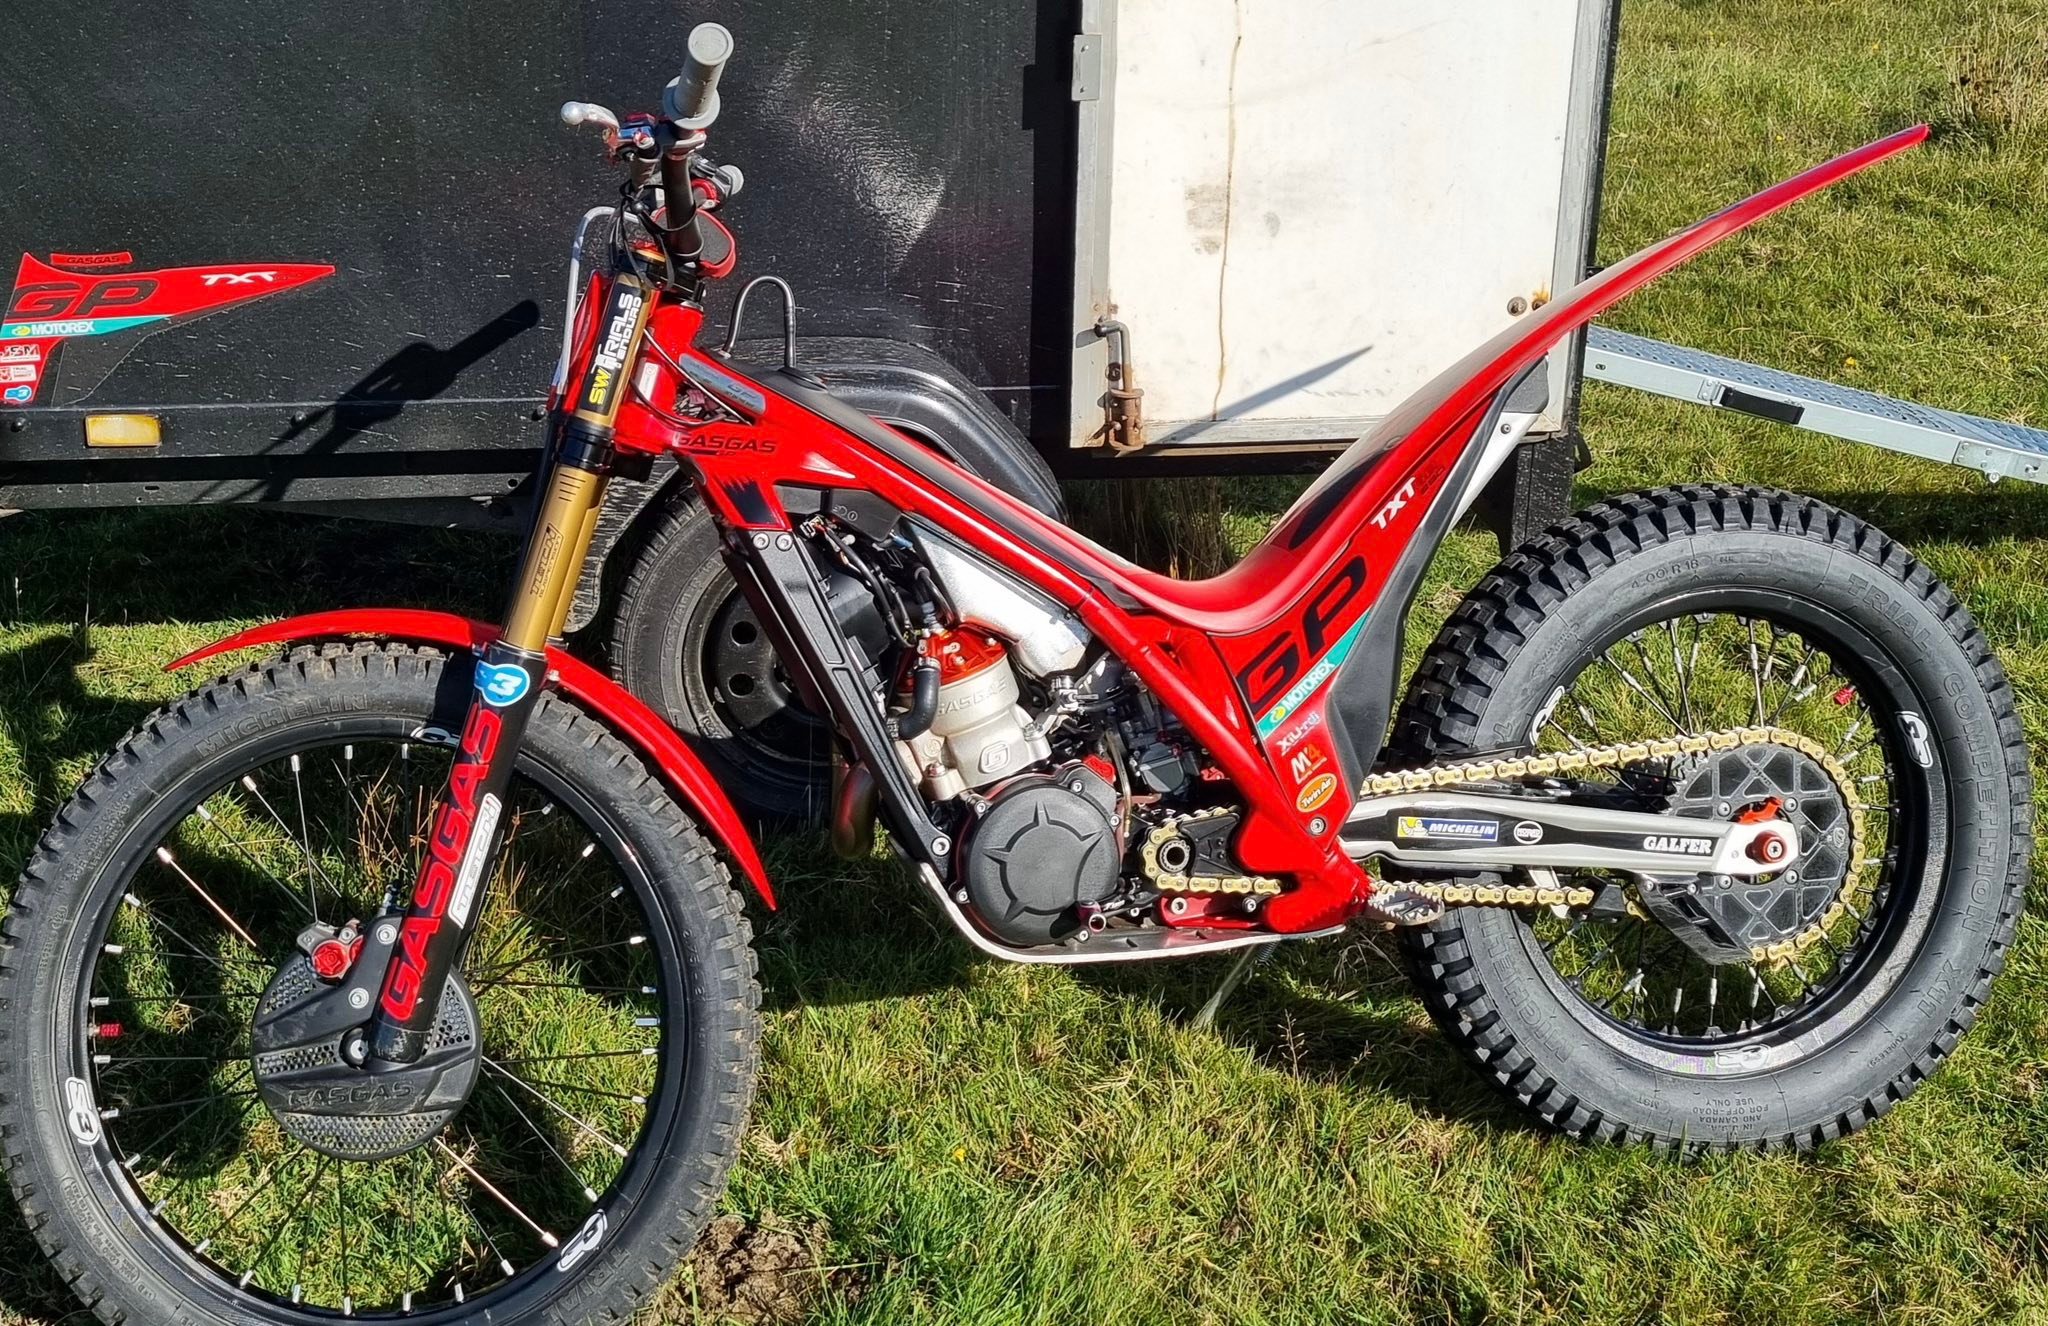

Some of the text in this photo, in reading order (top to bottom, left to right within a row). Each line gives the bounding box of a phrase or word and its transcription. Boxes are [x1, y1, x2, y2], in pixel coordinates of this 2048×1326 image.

[200, 270, 278, 286] TXT
[5, 278, 160, 322] GP
[31, 320, 96, 336] MOTOREX
[589, 367, 612, 405] SW
[1370, 476, 1416, 529] TXT
[1236, 555, 1368, 719] GP
[1283, 658, 1337, 712] MOTOREX
[196, 696, 368, 756] MICHELIN
[1848, 572, 1999, 933] TRIAL COMPETITION
[1428, 822, 1496, 835] MICHELIN
[1643, 835, 1713, 856] GALFER
[381, 702, 503, 1021] GASGAS
[1699, 1113, 1762, 1123] AND CANADA
[1705, 1097, 1755, 1107] USE ONLY
[1749, 1103, 1769, 1113] FOR
